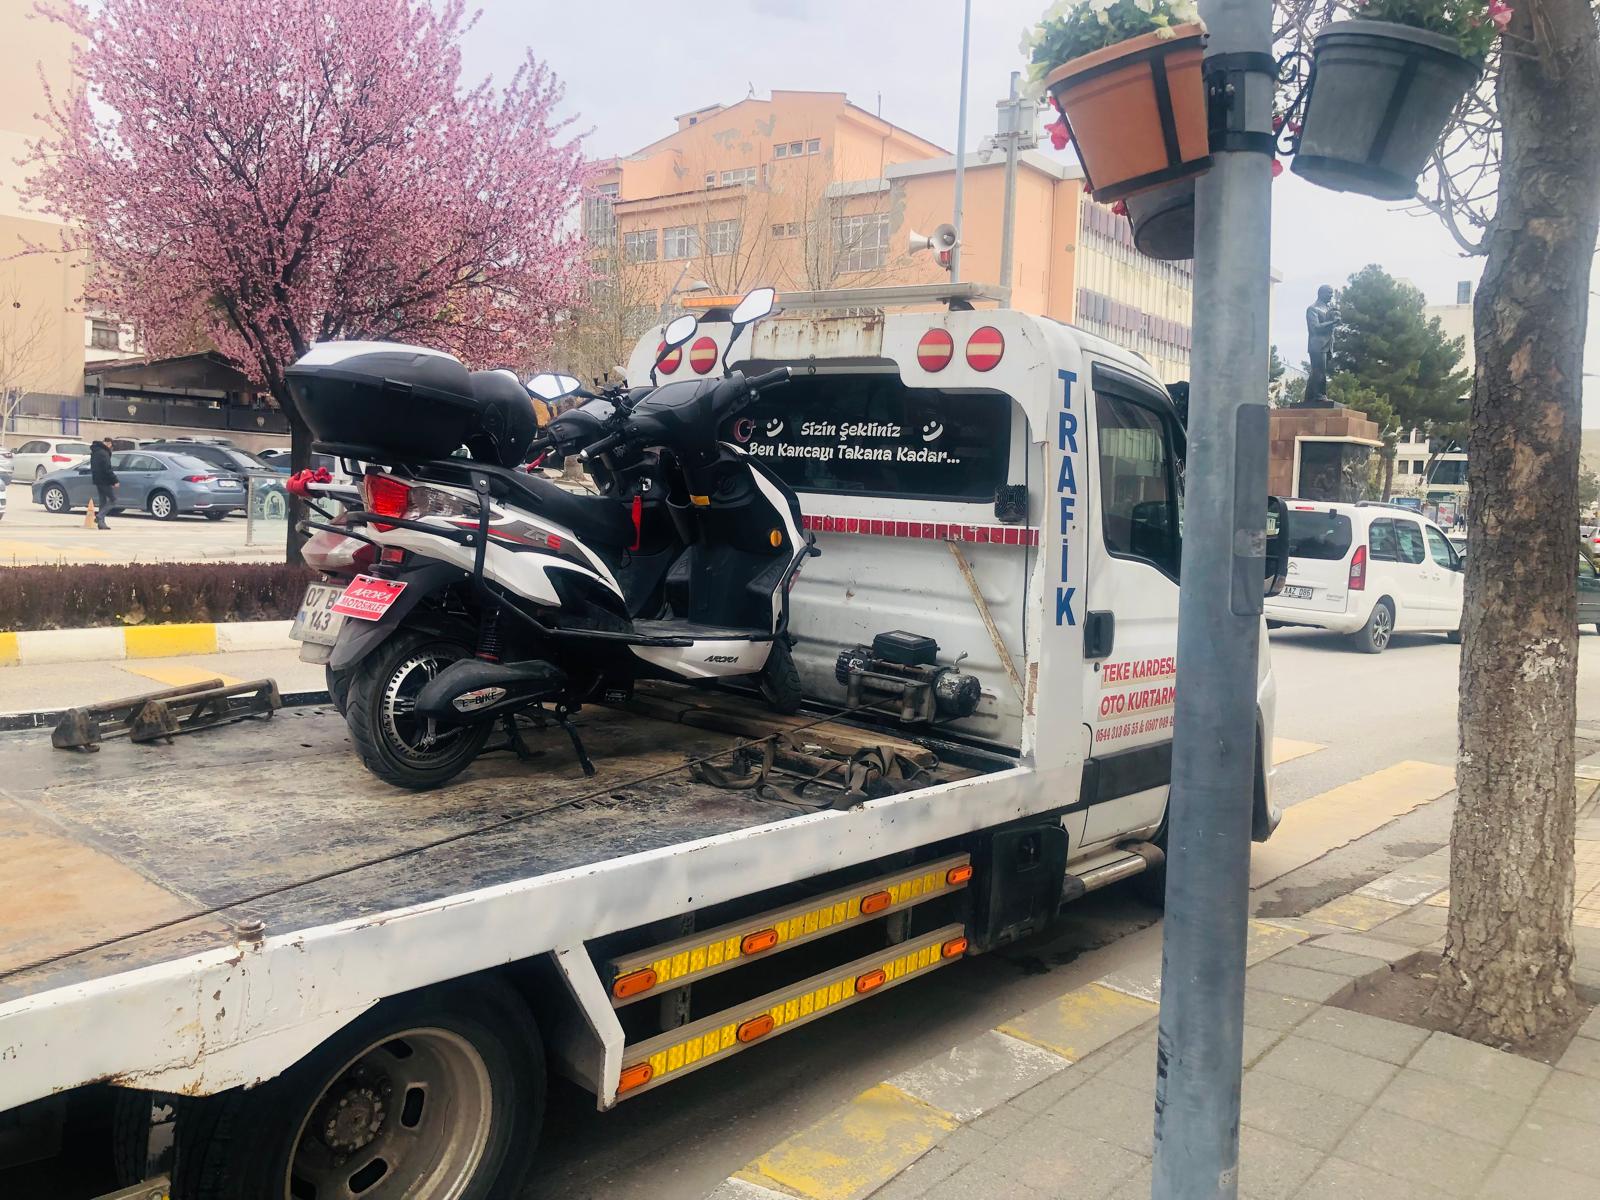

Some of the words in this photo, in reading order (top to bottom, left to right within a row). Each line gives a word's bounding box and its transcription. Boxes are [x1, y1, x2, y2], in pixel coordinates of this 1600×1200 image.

[801, 421, 836, 436] Sizin
[840, 422, 901, 441] Şekliniz
[749, 442, 775, 457] Ben
[777, 443, 834, 461] Kancayı
[838, 445, 893, 461] Takana
[896, 446, 960, 464] Kadar...
[1056, 369, 1078, 626] TRAFİK
[326, 590, 342, 609] B
[351, 588, 393, 601] ARORA
[310, 610, 332, 632] 143
[1103, 662, 1131, 682] TEKE
[1101, 694, 1125, 715] OTO
